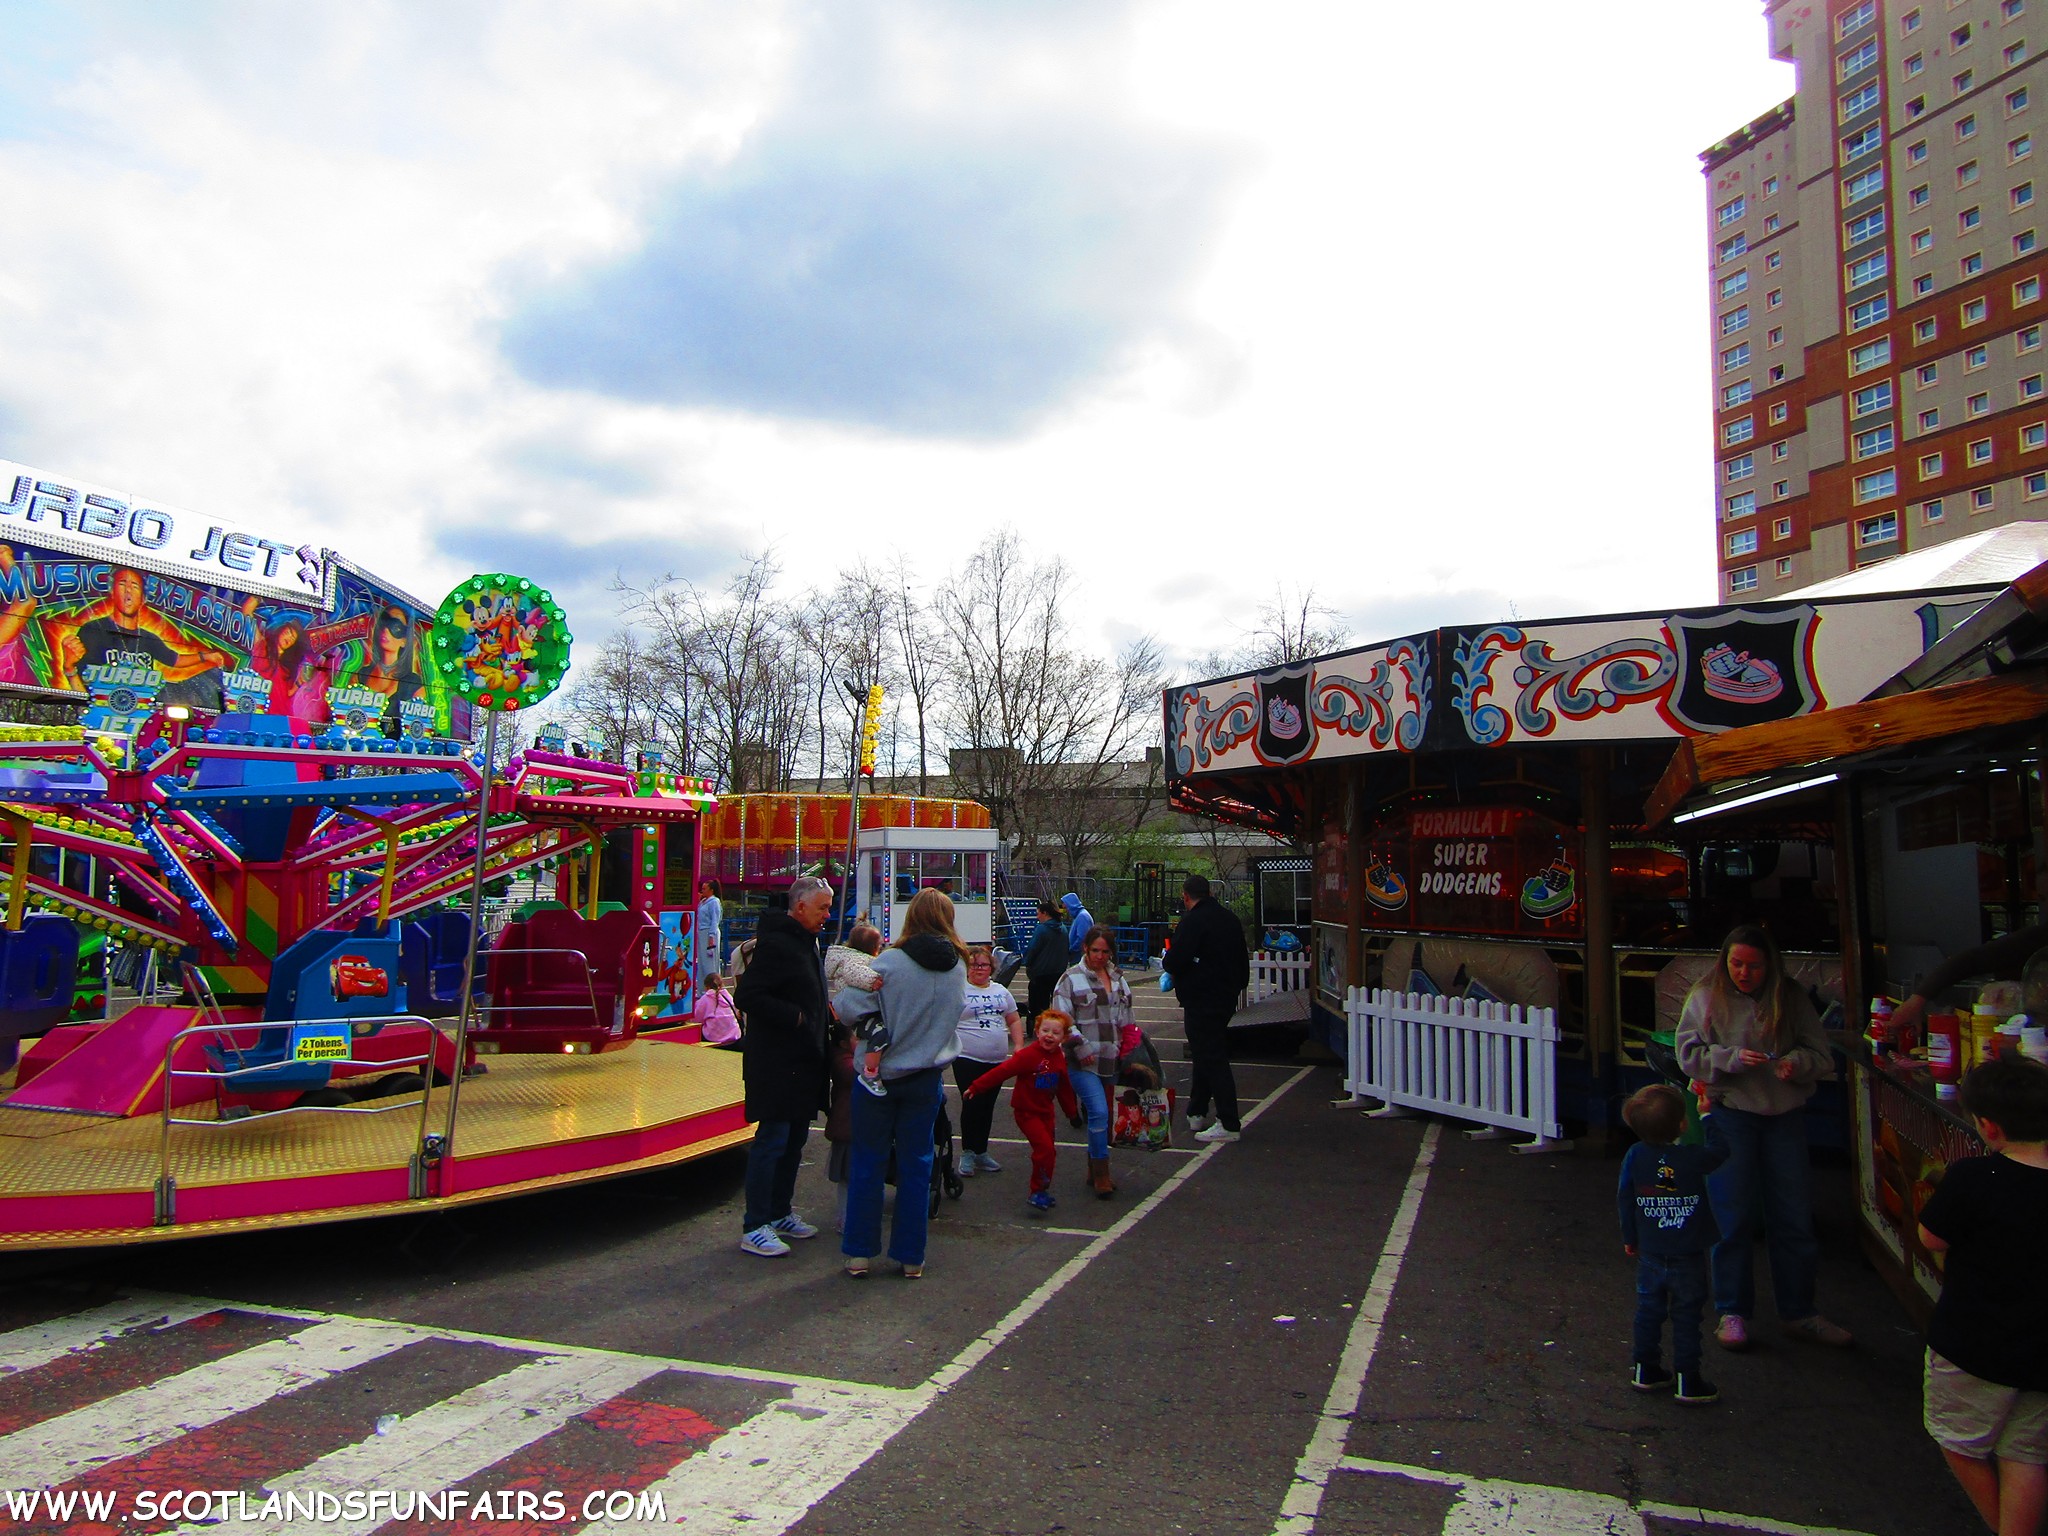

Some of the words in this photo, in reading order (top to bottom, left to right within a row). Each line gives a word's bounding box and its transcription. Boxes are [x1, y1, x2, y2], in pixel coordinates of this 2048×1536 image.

[190, 526, 294, 577] JET
[0, 564, 112, 604] MUSIC
[145, 574, 258, 650] EXPLOSION
[82, 664, 163, 687] TURBO
[222, 671, 273, 694] TURBO
[328, 686, 387, 708] TURBO
[400, 700, 436, 718] TURBO
[540, 724, 568, 740] TURBO
[642, 741, 665, 753] TURBO
[1412, 810, 1492, 836] FORMULA
[1433, 842, 1488, 867] SUPER
[1419, 871, 1502, 896] DODGEMS
[297, 1050, 313, 1058] Per
[315, 1048, 347, 1058] person
[302, 1039, 308, 1049] 2
[310, 1038, 343, 1048] Tokens
[1636, 1196, 1656, 1207] OUT
[1657, 1196, 1681, 1207] HERE
[1684, 1195, 1700, 1206] FOR
[1643, 1207, 1668, 1218] GOOD
[1668, 1206, 1695, 1218] TIMES
[1657, 1216, 1685, 1229] Only
